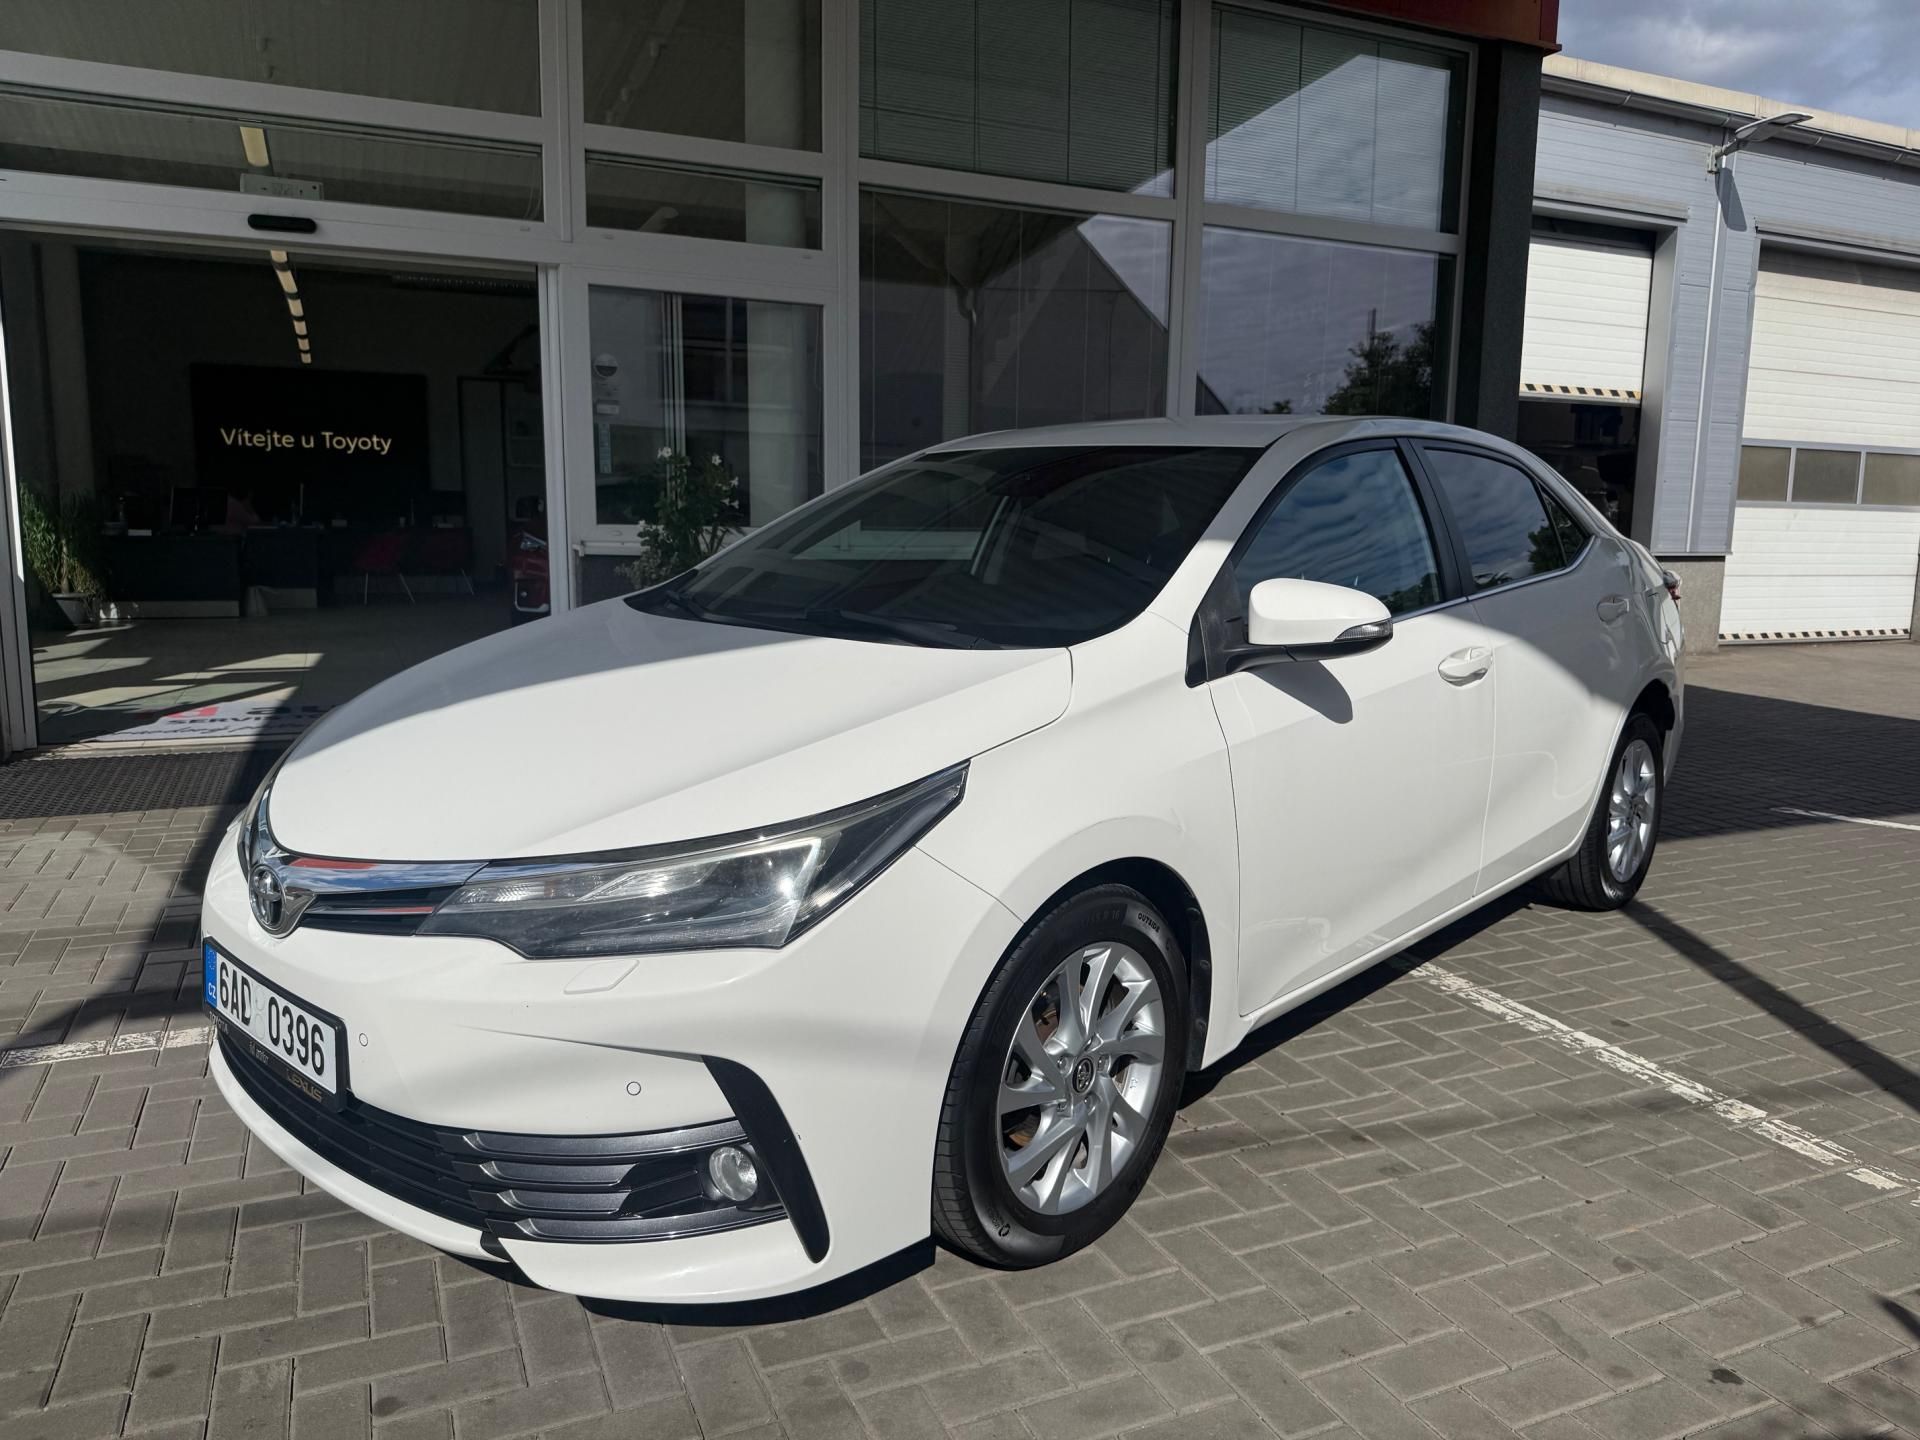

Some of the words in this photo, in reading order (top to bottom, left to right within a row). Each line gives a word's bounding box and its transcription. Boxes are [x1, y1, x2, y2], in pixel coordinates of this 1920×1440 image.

[220, 428, 295, 452] Vítejte
[301, 435, 314, 448] u
[321, 431, 392, 455] Toyoty
[1138, 913, 1161, 933] OUTSIDE
[208, 982, 216, 999] CZ
[219, 961, 252, 1026] 6AD
[268, 996, 325, 1077] 0396
[286, 1069, 323, 1102] LEXUS
